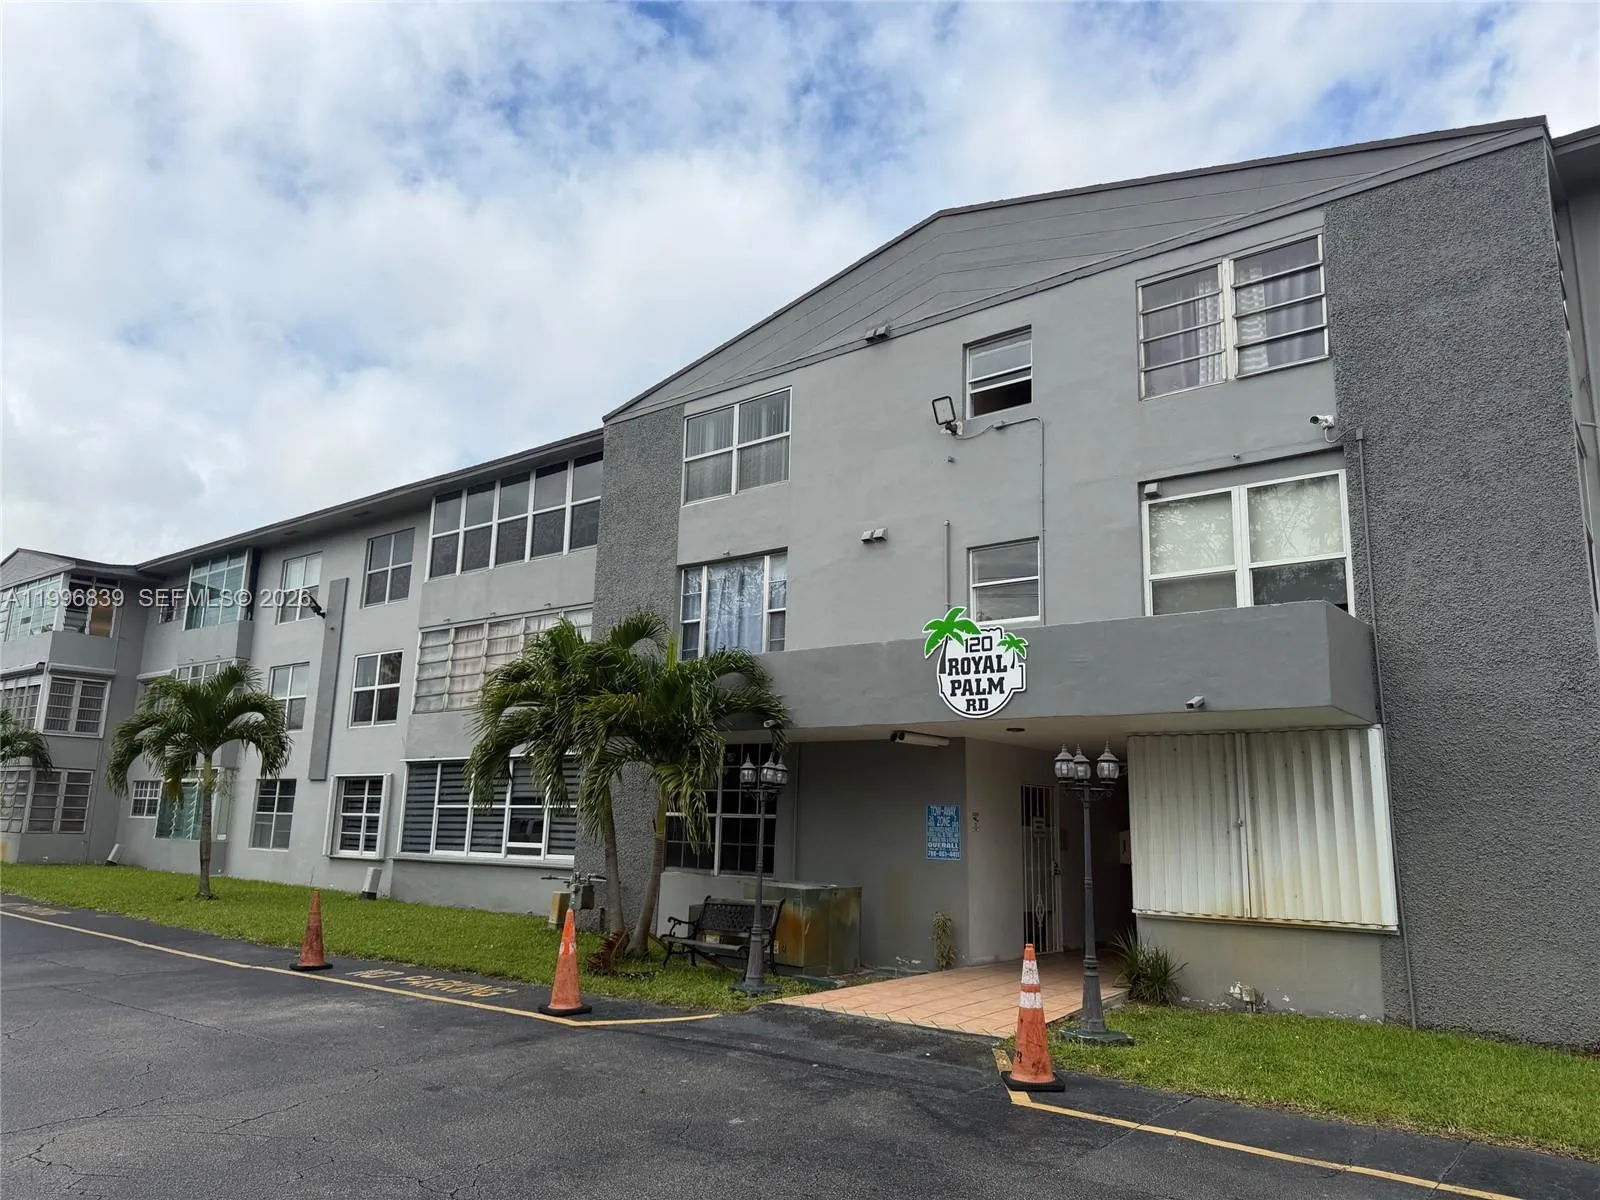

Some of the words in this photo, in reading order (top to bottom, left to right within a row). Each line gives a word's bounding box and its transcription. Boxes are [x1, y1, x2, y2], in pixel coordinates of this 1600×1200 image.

[965, 636, 993, 653] 120
[947, 655, 1008, 676] ROYAL
[949, 677, 1005, 697] PALM
[965, 698, 989, 712] RD
